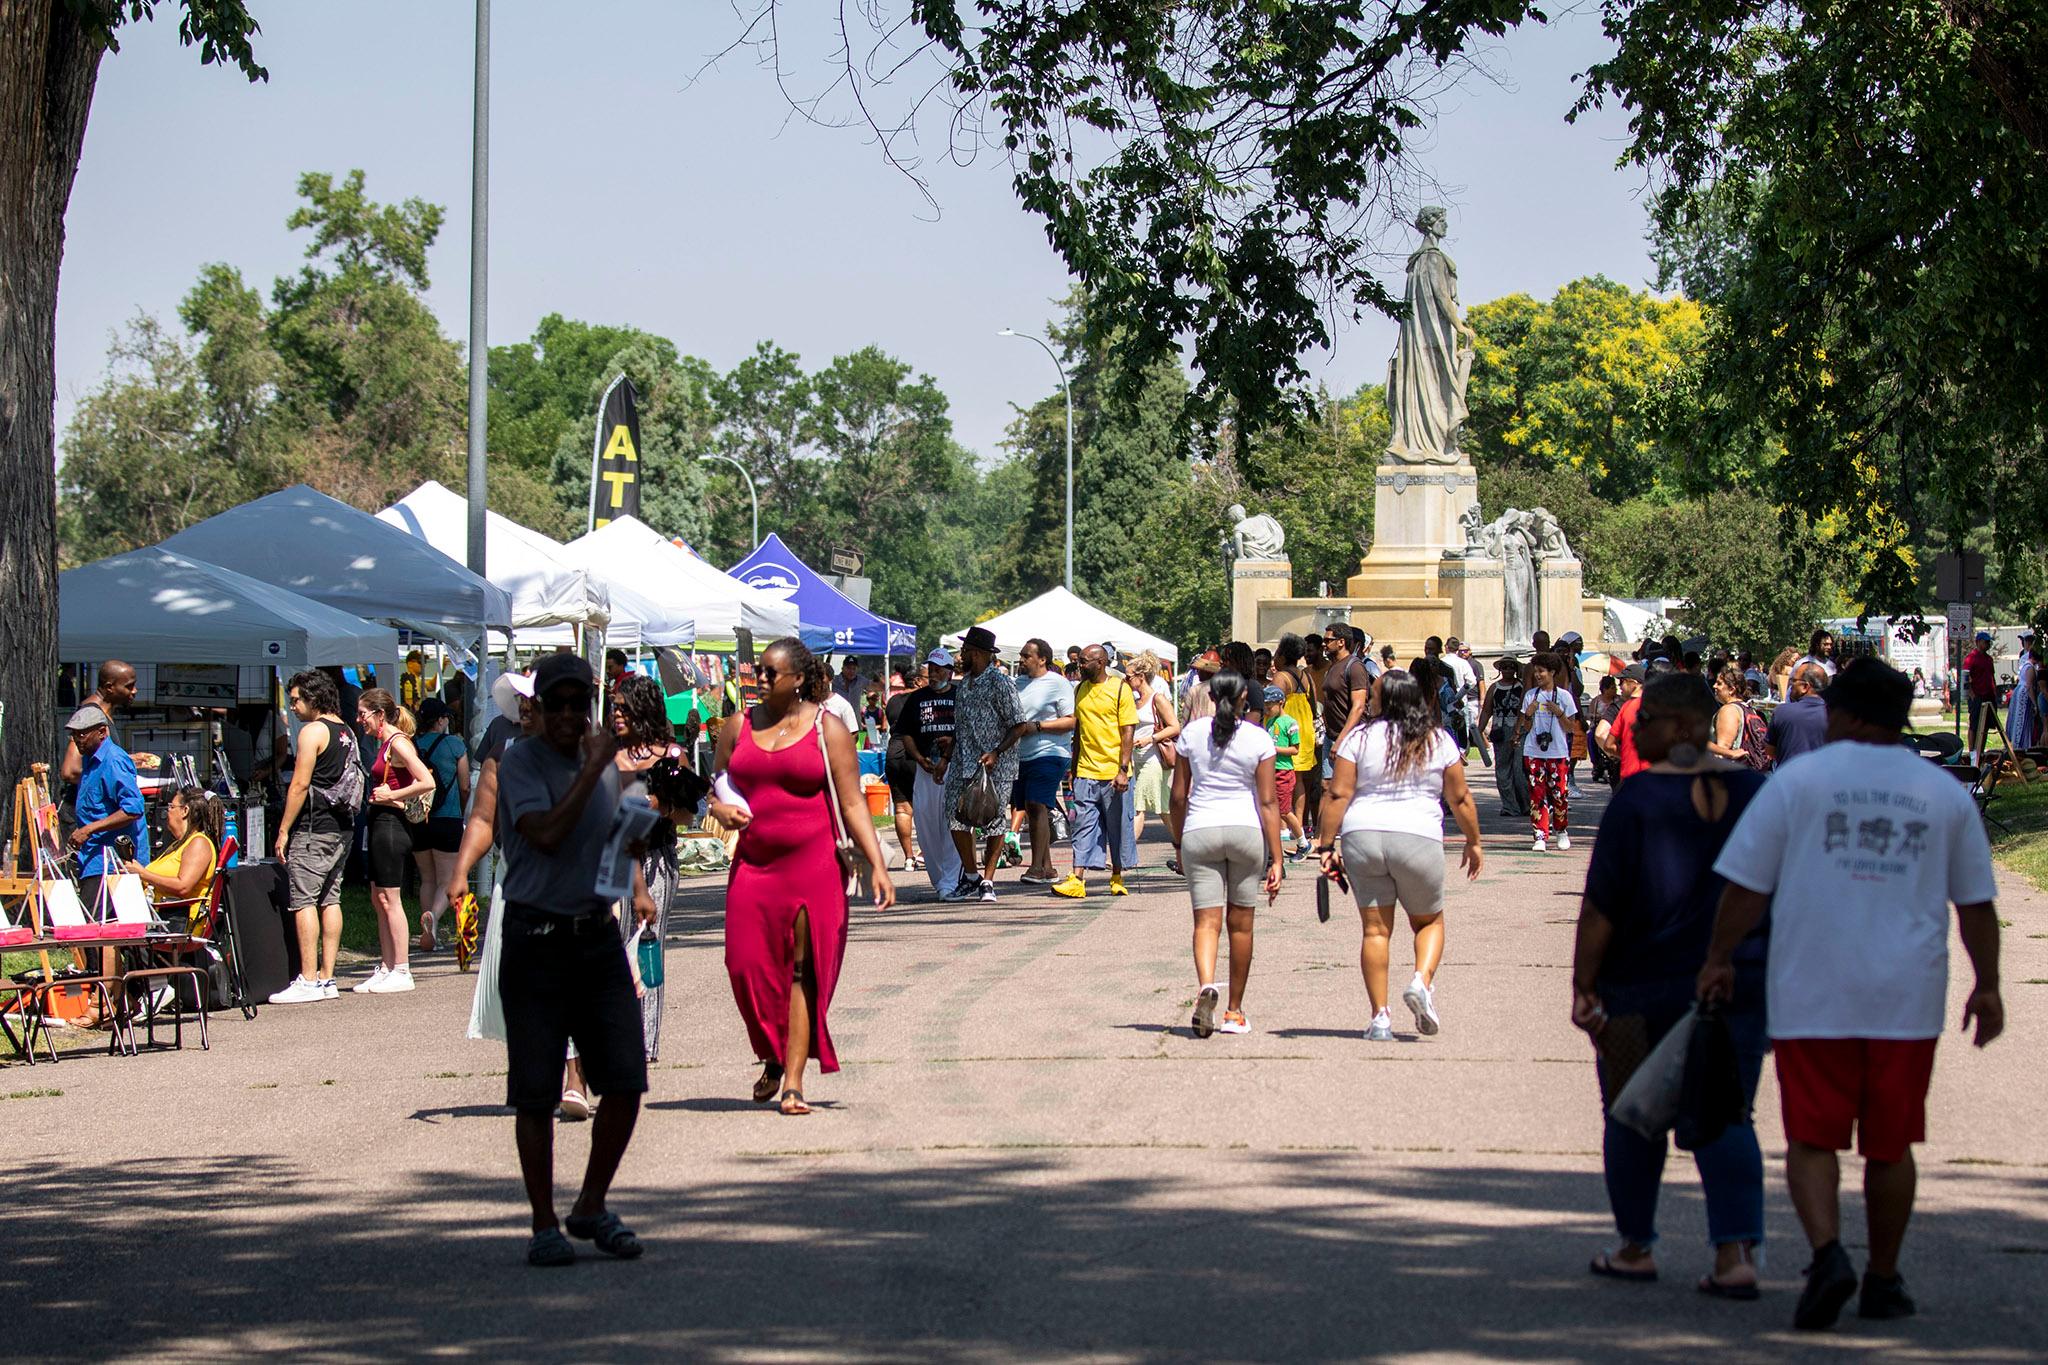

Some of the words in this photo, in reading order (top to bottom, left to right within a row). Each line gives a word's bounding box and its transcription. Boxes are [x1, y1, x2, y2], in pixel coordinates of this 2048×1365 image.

[596, 424, 638, 530] AT
[835, 555, 844, 566] ONE
[845, 558, 854, 568] WAY
[919, 700, 933, 708] GET
[938, 724, 955, 732] NECKS
[1833, 791, 1848, 805] TO
[1852, 790, 1868, 804] ALL
[1871, 790, 1890, 805] THE
[1893, 793, 1928, 814] GRILLS
